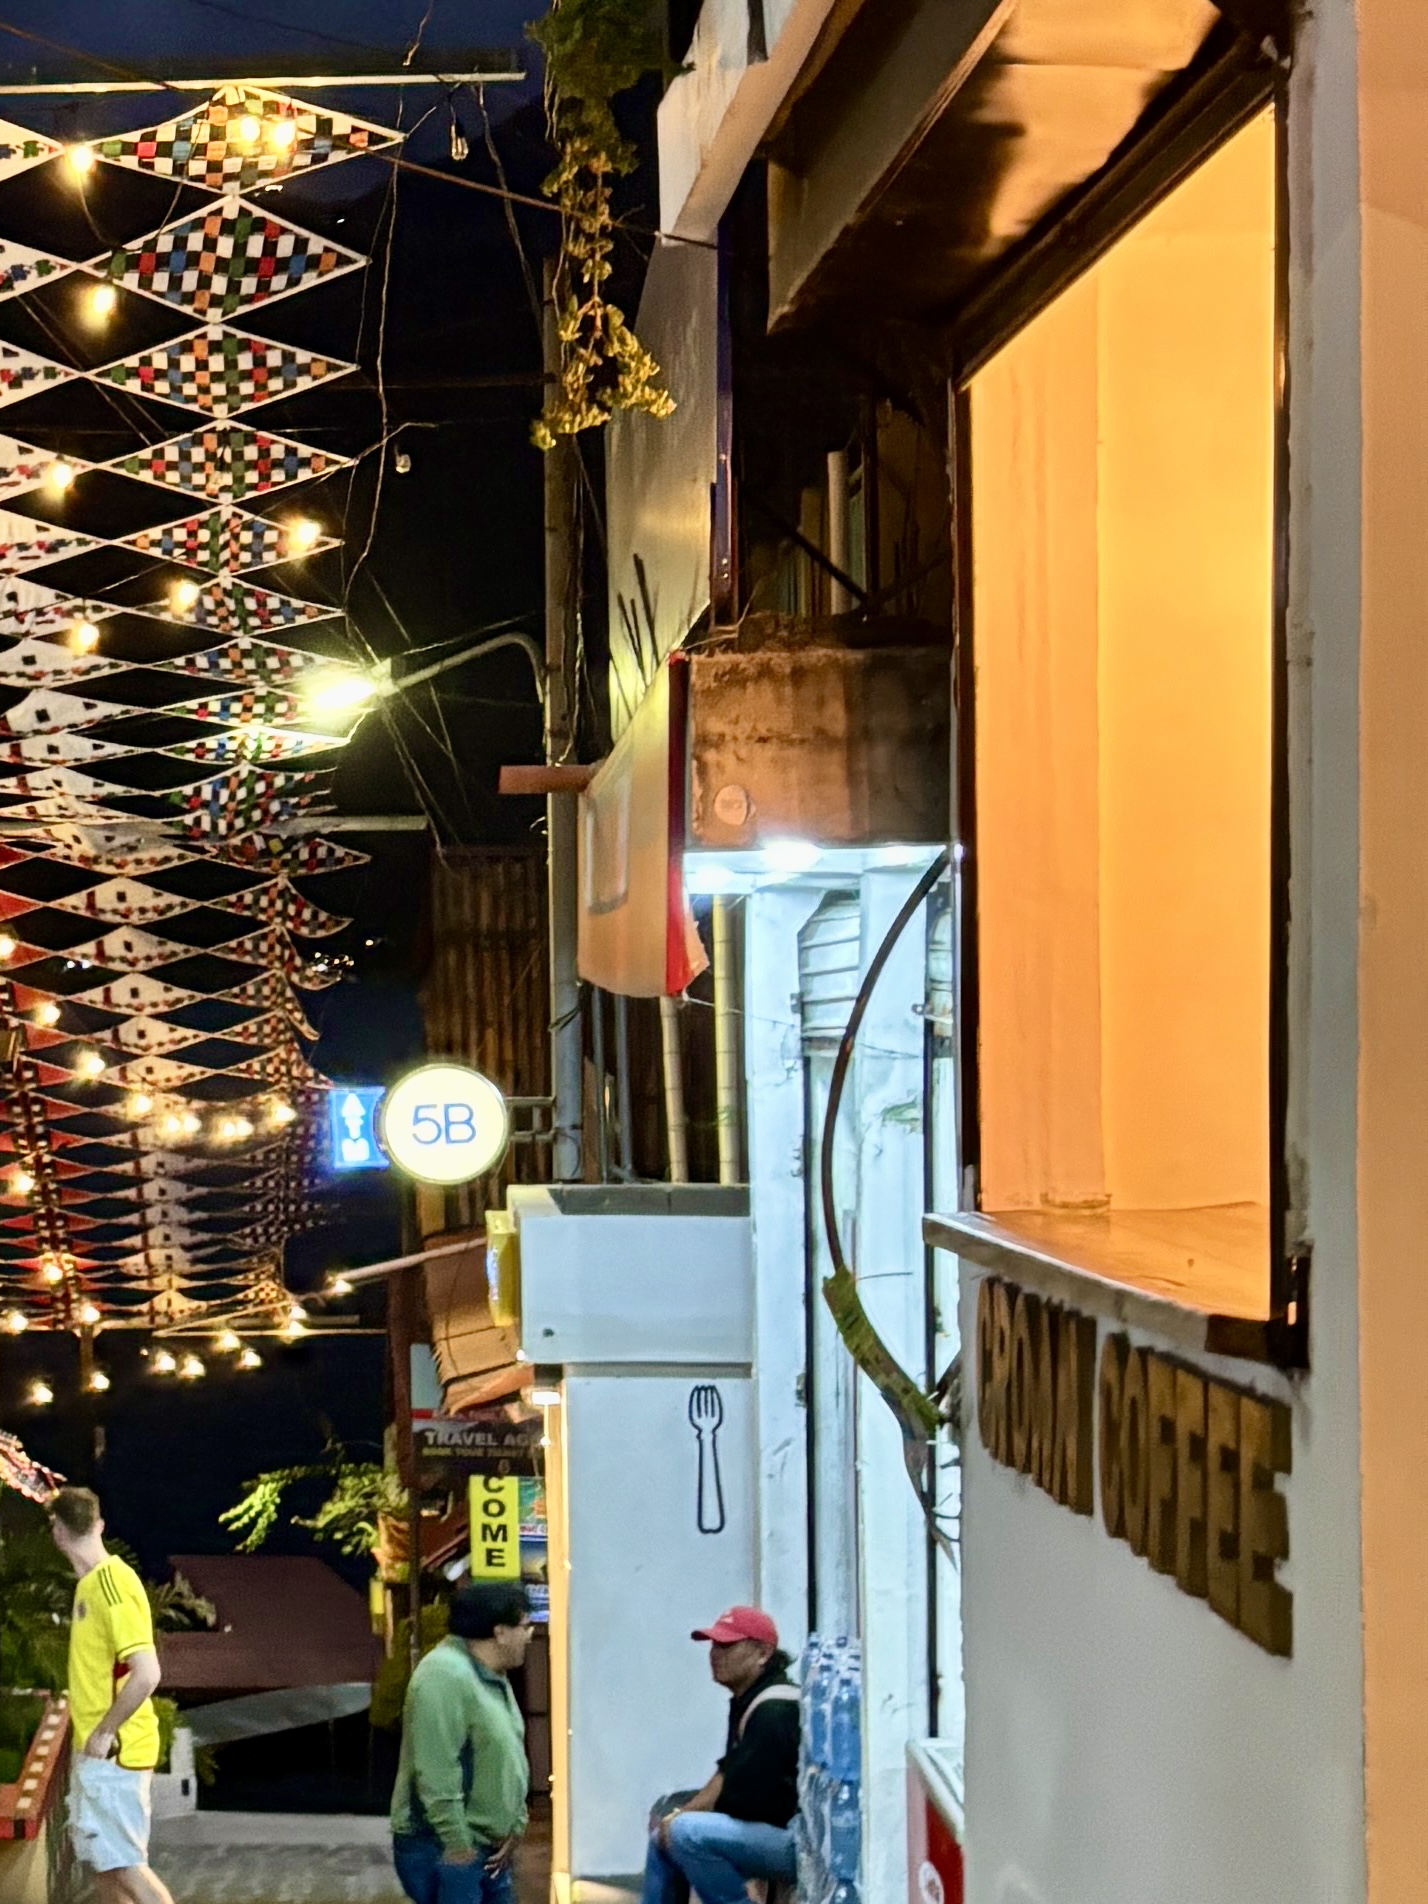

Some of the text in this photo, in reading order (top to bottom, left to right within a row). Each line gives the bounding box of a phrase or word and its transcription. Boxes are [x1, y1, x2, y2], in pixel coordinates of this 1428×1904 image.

[412, 1102, 477, 1145] 5B
[424, 1430, 500, 1447] TRAVEL
[1098, 1332, 1294, 1658] COFFEE
